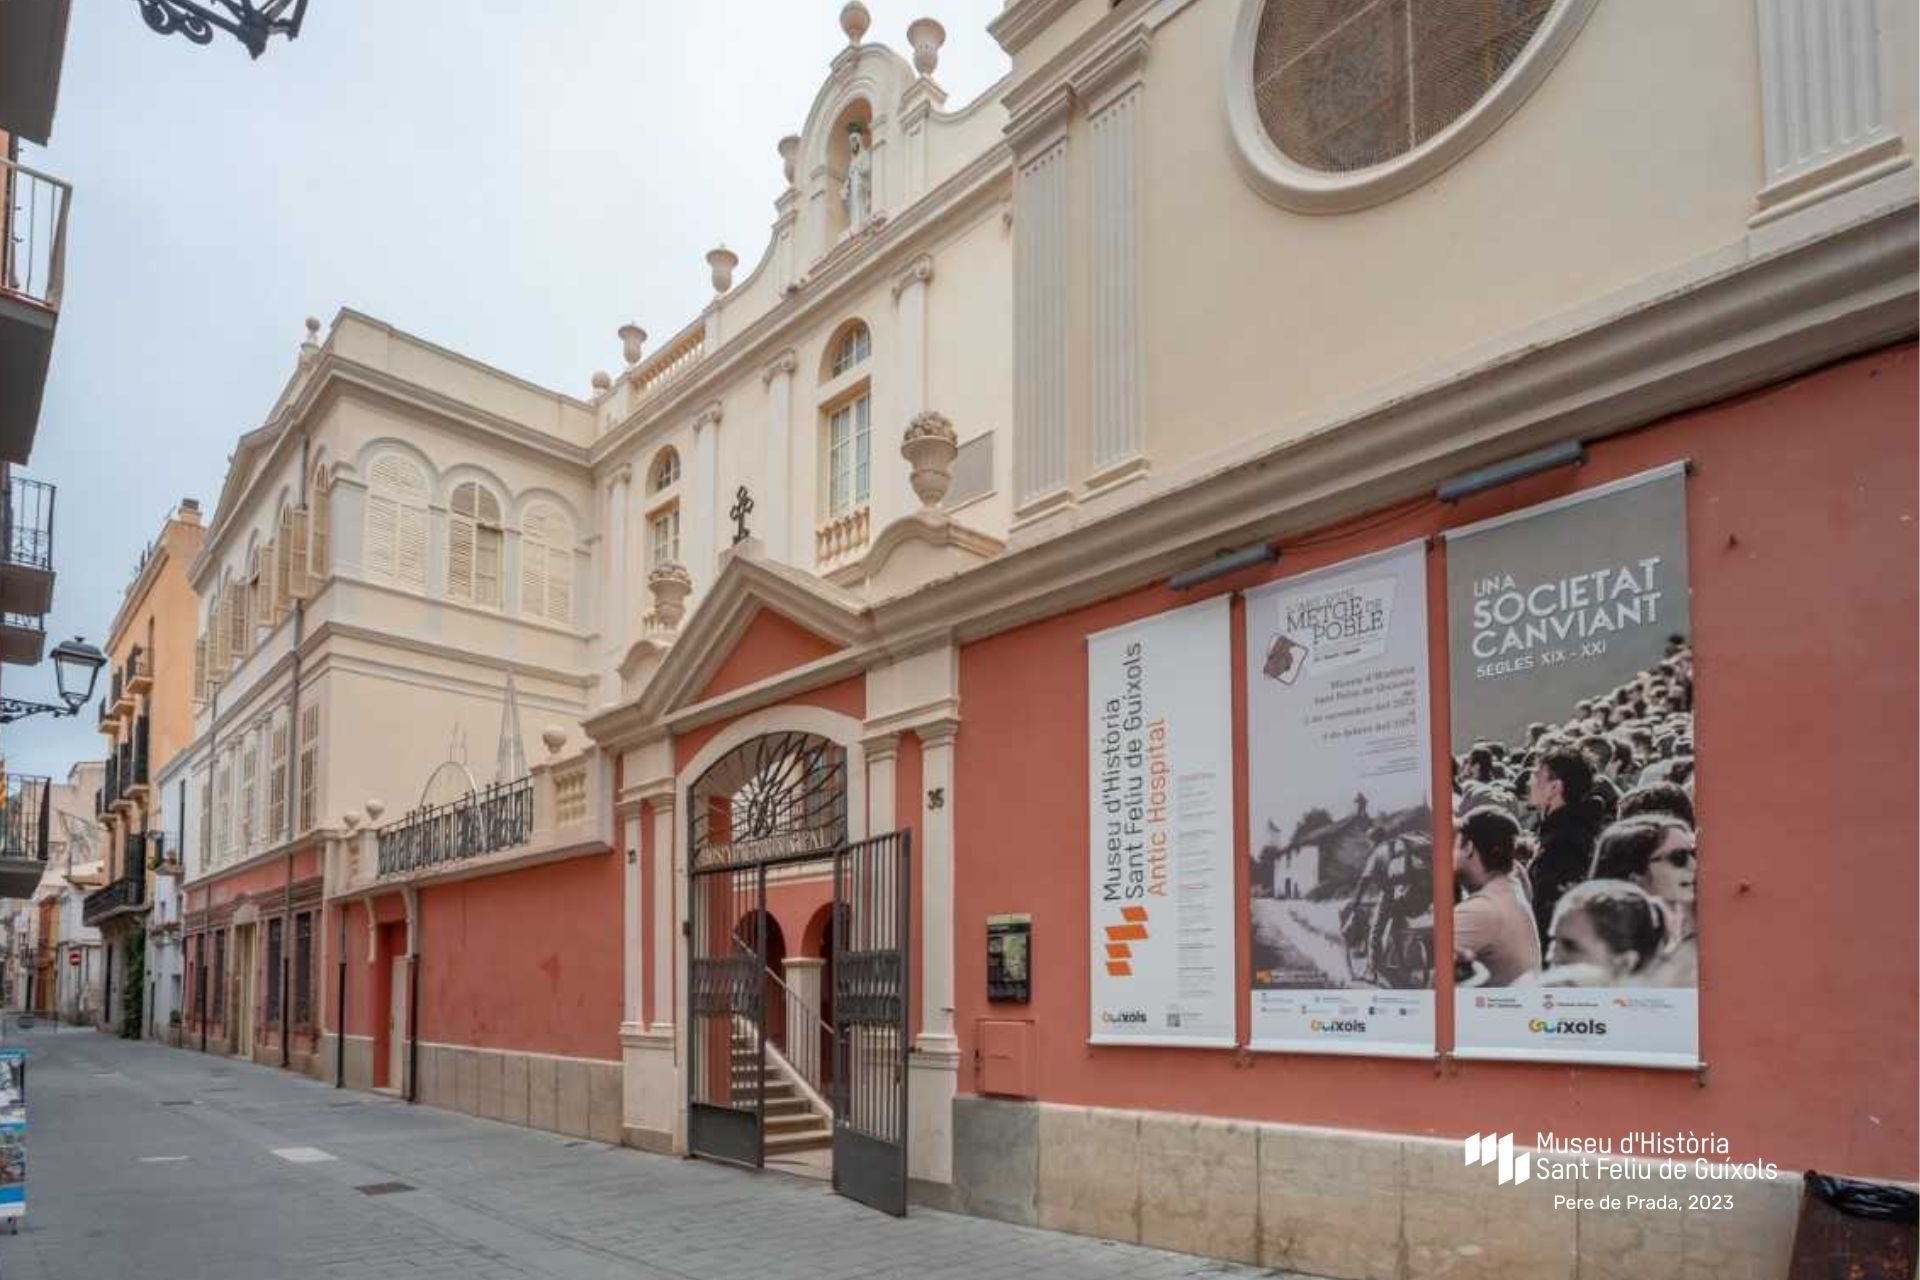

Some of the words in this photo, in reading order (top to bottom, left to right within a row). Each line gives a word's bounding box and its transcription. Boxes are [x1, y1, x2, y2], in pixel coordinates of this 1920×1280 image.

[1473, 575, 1516, 598] UNA
[1473, 557, 1662, 629] SOCIETAT
[1314, 609, 1384, 644] POBLE
[1472, 592, 1662, 658] CANVIANT
[1476, 655, 1535, 679] SEGLES
[1541, 650, 1567, 666] XIX
[1582, 640, 1606, 658] XXI
[1124, 738, 1143, 768] de
[1146, 717, 1170, 823] Hospital
[1124, 775, 1144, 835] Feliu
[1102, 822, 1122, 901] Museu
[1124, 843, 1144, 898] Sant
[1147, 832, 1168, 897] Antic
